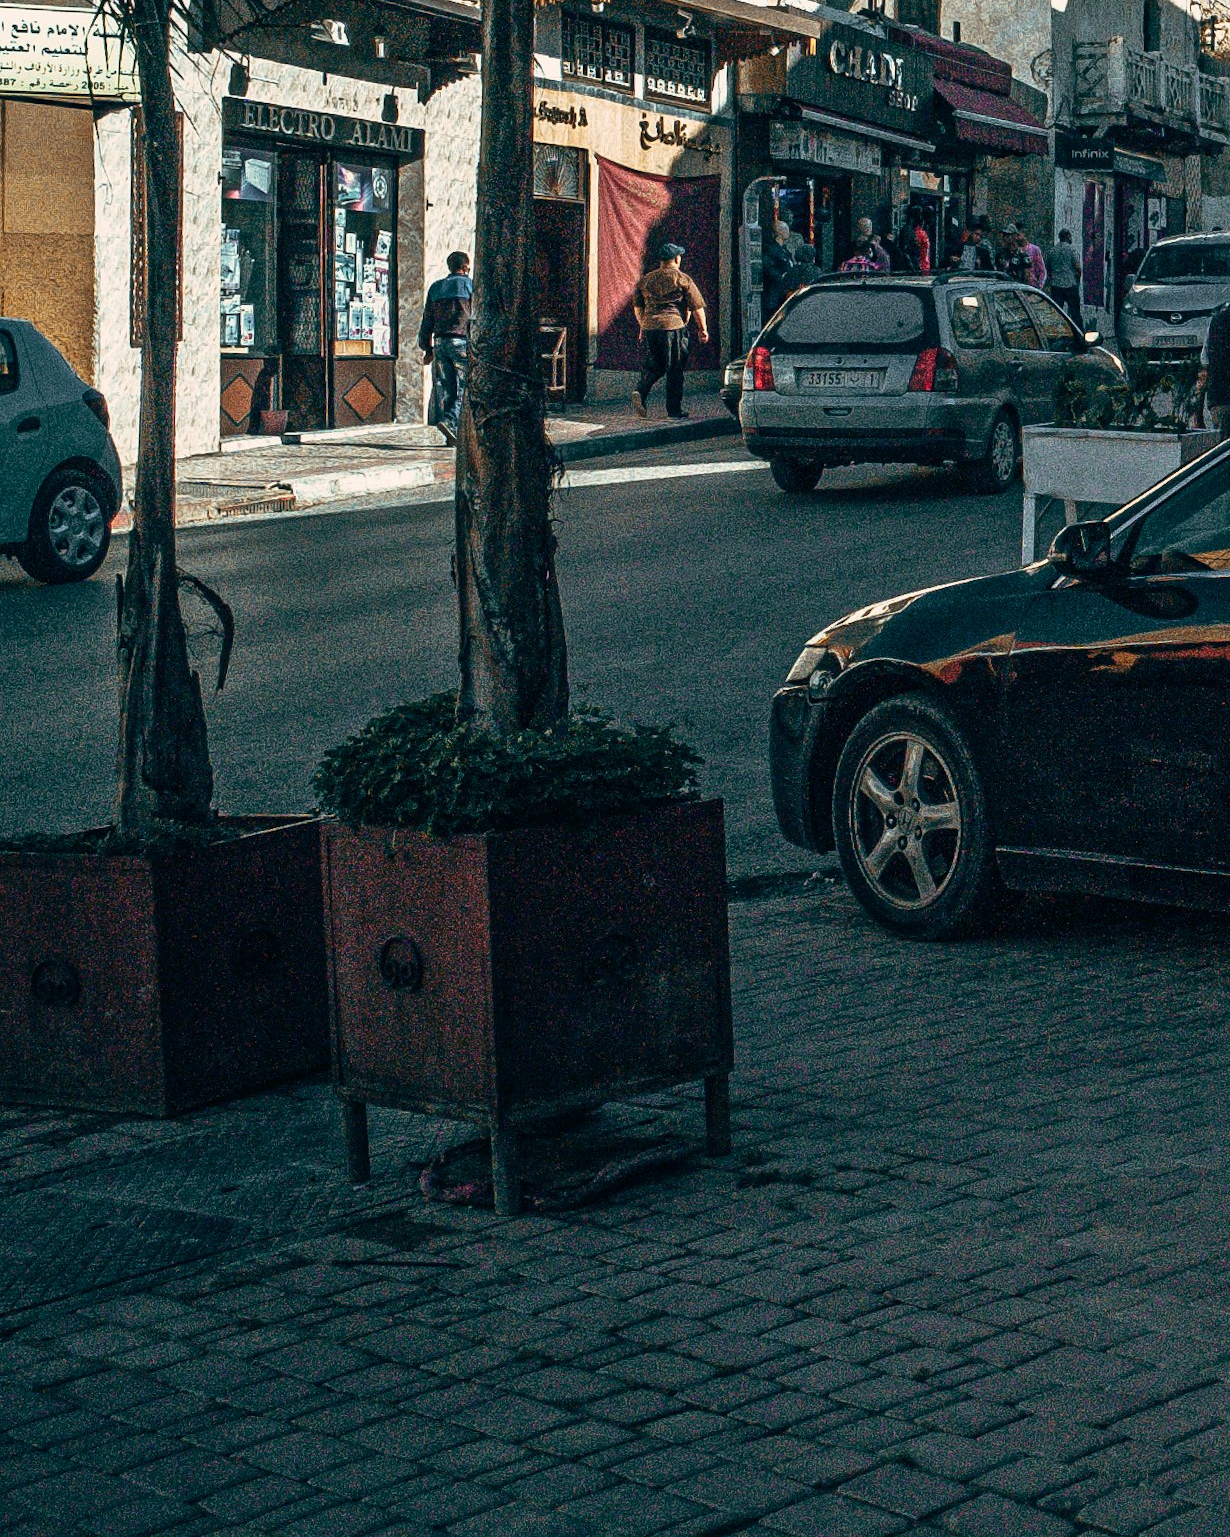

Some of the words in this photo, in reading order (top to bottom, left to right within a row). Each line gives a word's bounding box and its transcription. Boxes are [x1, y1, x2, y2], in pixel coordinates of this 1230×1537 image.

[11, 19, 41, 39] نافع
[41, 43, 89, 58] لتعليم
[829, 40, 904, 90] CHADI
[81, 81, 105, 91] 205
[242, 102, 336, 141] ELECTRO
[349, 119, 413, 154] ALAMI
[1071, 148, 1110, 159] Infinix
[808, 373, 843, 386] 33155
